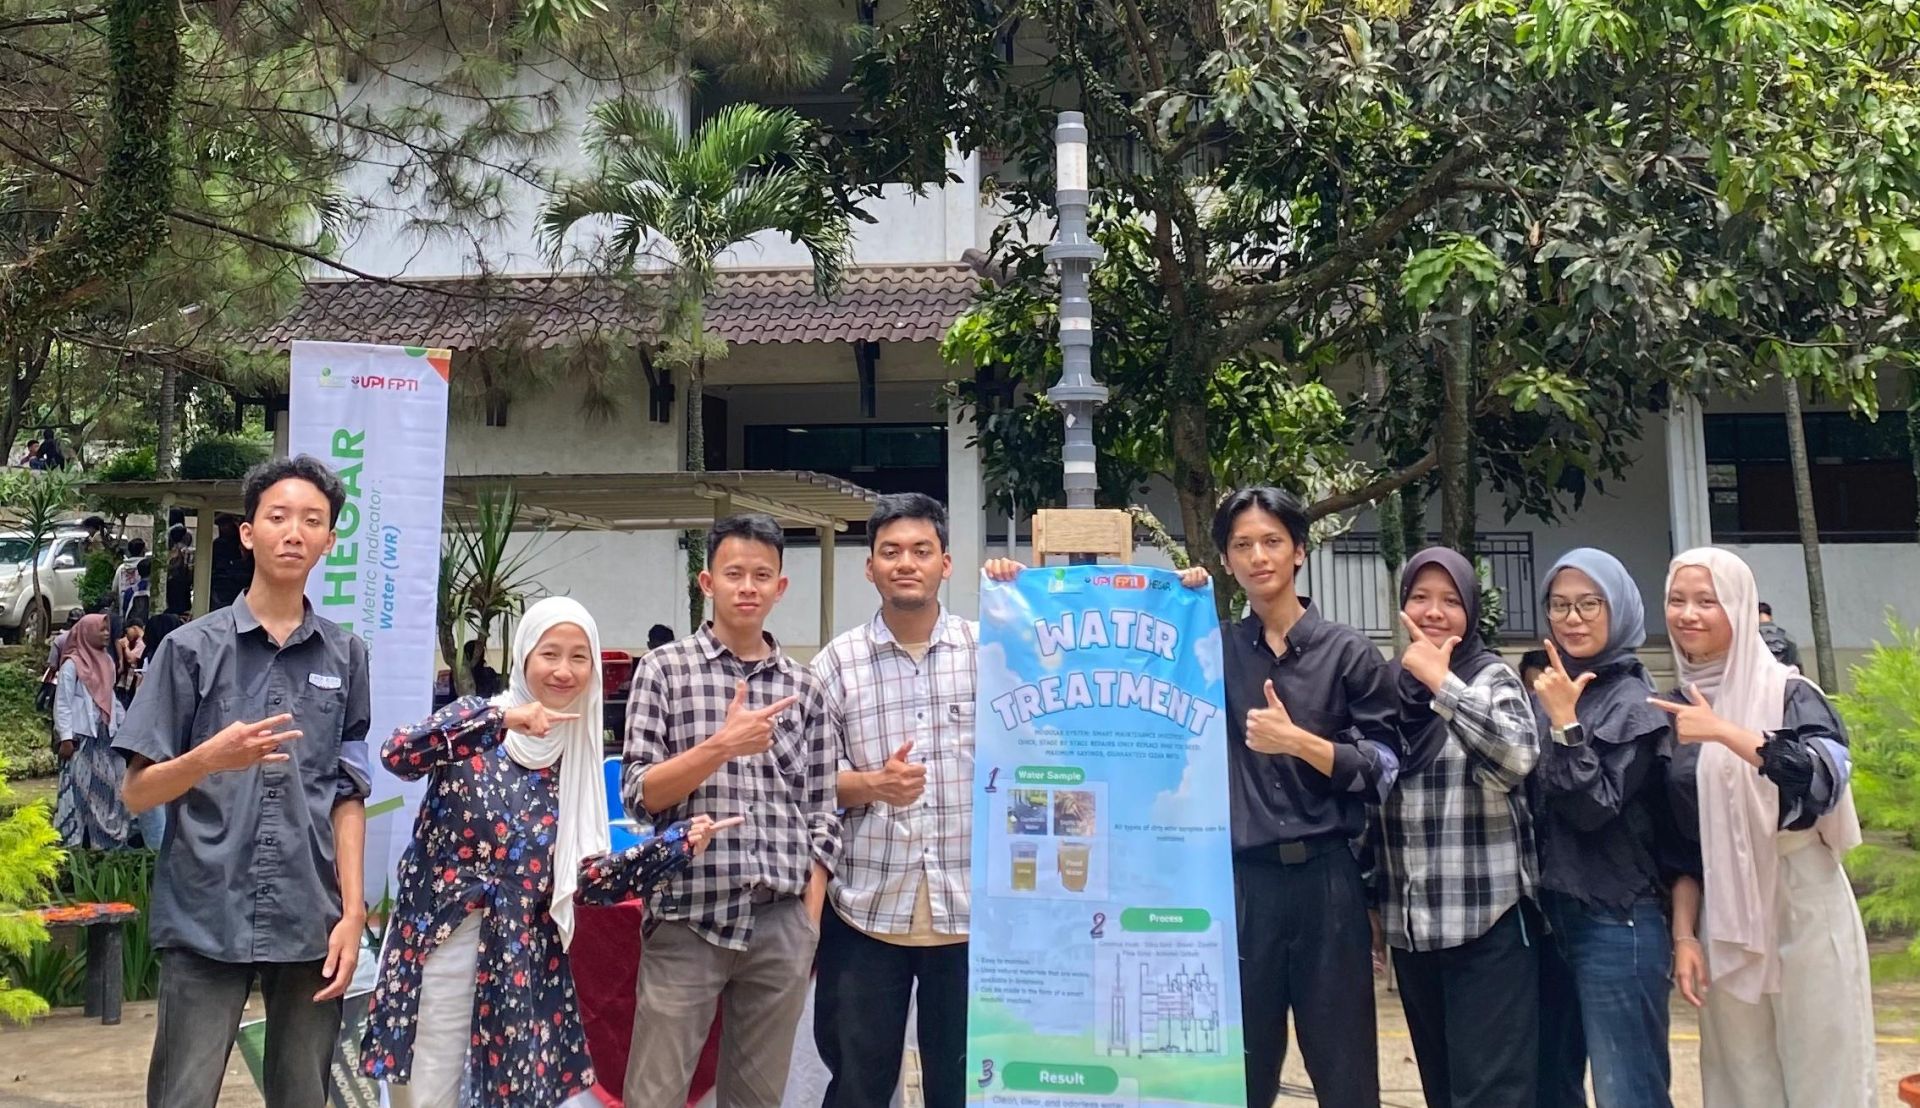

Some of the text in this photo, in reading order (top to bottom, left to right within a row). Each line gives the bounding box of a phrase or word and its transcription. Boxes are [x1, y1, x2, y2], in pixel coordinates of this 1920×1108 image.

[361, 376, 418, 391] UPI FPTI
[322, 428, 366, 605] HEGAR
[380, 525, 401, 629] Water (WR)
[361, 569, 377, 624] Metric
[1034, 609, 1179, 661] WATER
[991, 670, 1217, 736] TREATMENT
[984, 767, 1000, 793] 1
[1018, 770, 1082, 782] Water Sample
[1089, 912, 1106, 939] 2
[1149, 913, 1184, 924] Process
[978, 1059, 994, 1088] 3
[1039, 1070, 1085, 1086] Result
